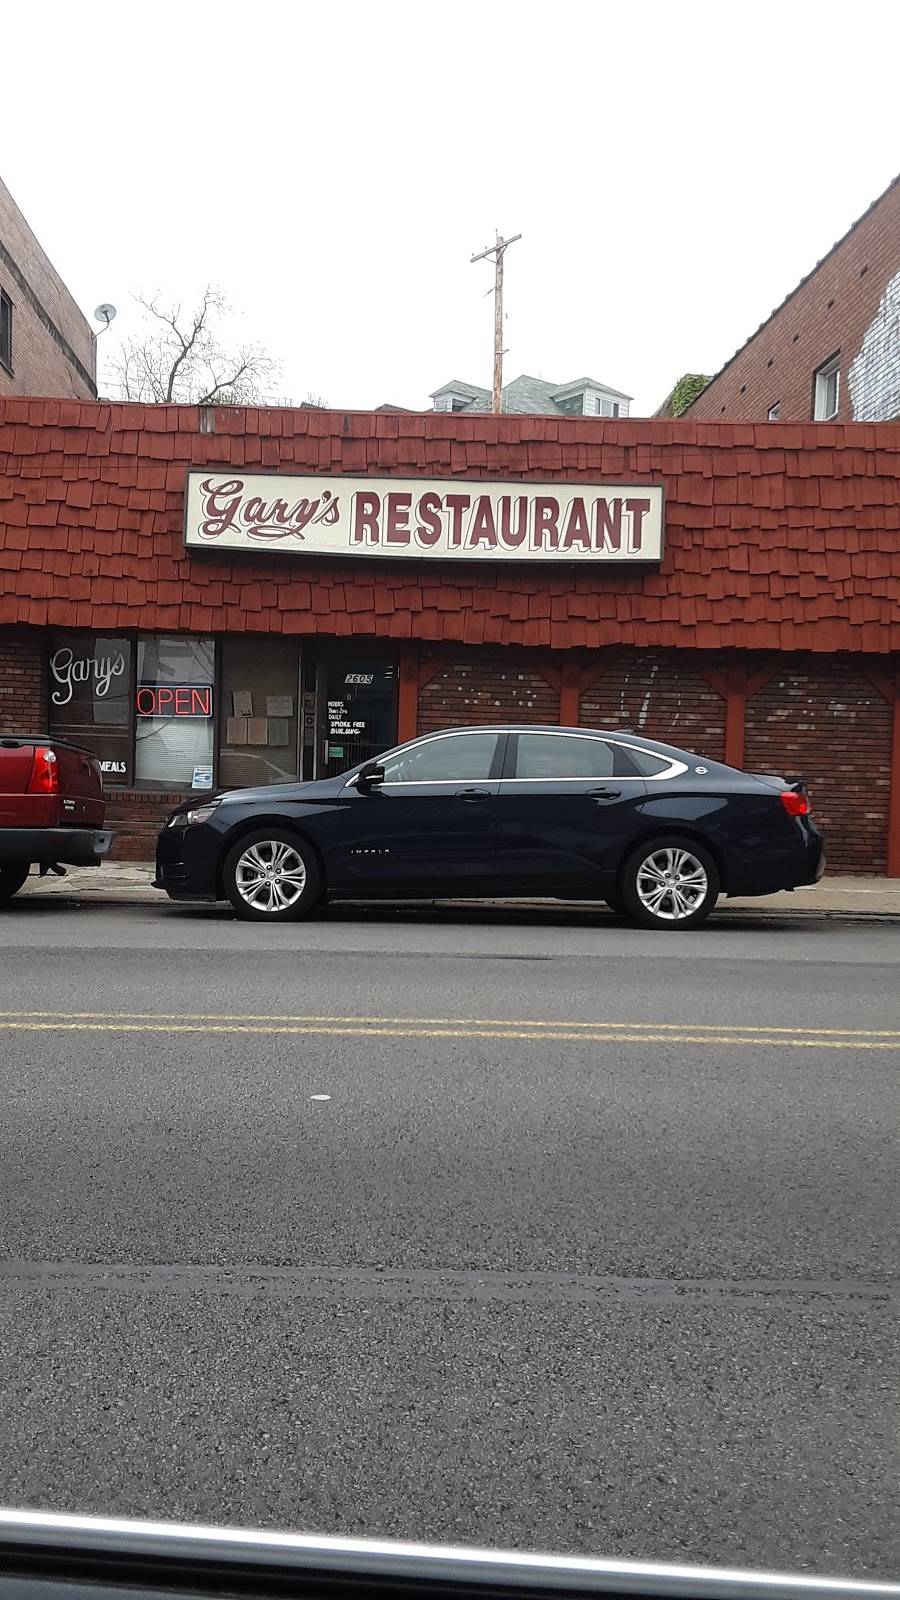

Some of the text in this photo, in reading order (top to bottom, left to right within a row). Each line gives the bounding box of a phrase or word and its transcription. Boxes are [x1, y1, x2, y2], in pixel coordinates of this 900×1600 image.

[199, 477, 651, 554] Gary's RESTAURANT
[49, 647, 125, 705] Gary's
[346, 674, 373, 684] 2605
[136, 687, 210, 715] OPEN
[98, 761, 126, 773] MEALS
